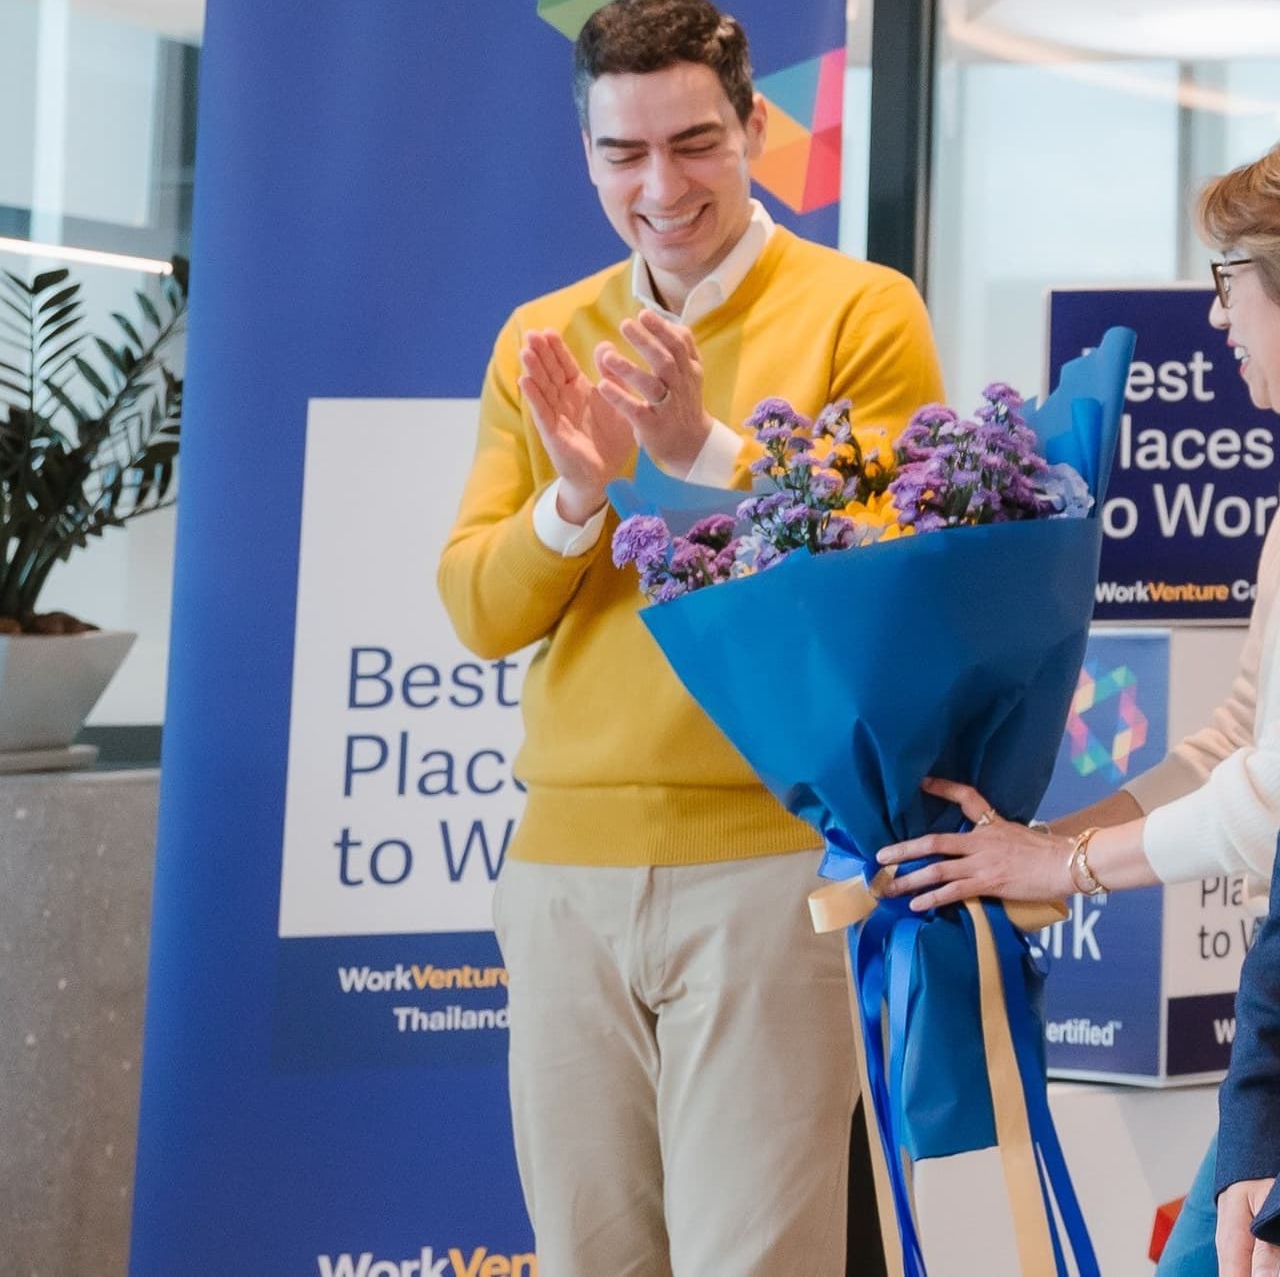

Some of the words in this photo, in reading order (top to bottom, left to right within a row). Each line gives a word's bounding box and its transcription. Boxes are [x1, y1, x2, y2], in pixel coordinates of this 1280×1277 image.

[1124, 350, 1215, 402] est
[1119, 413, 1275, 471] laces
[1103, 497, 1138, 539] o
[1095, 580, 1229, 603] WorkVenture
[347, 646, 520, 711] Best
[343, 730, 528, 798] Plac
[334, 826, 413, 887] to
[1198, 925, 1231, 960] to
[1046, 1018, 1114, 1047] ertified
[317, 1246, 537, 1277] WorkVen
